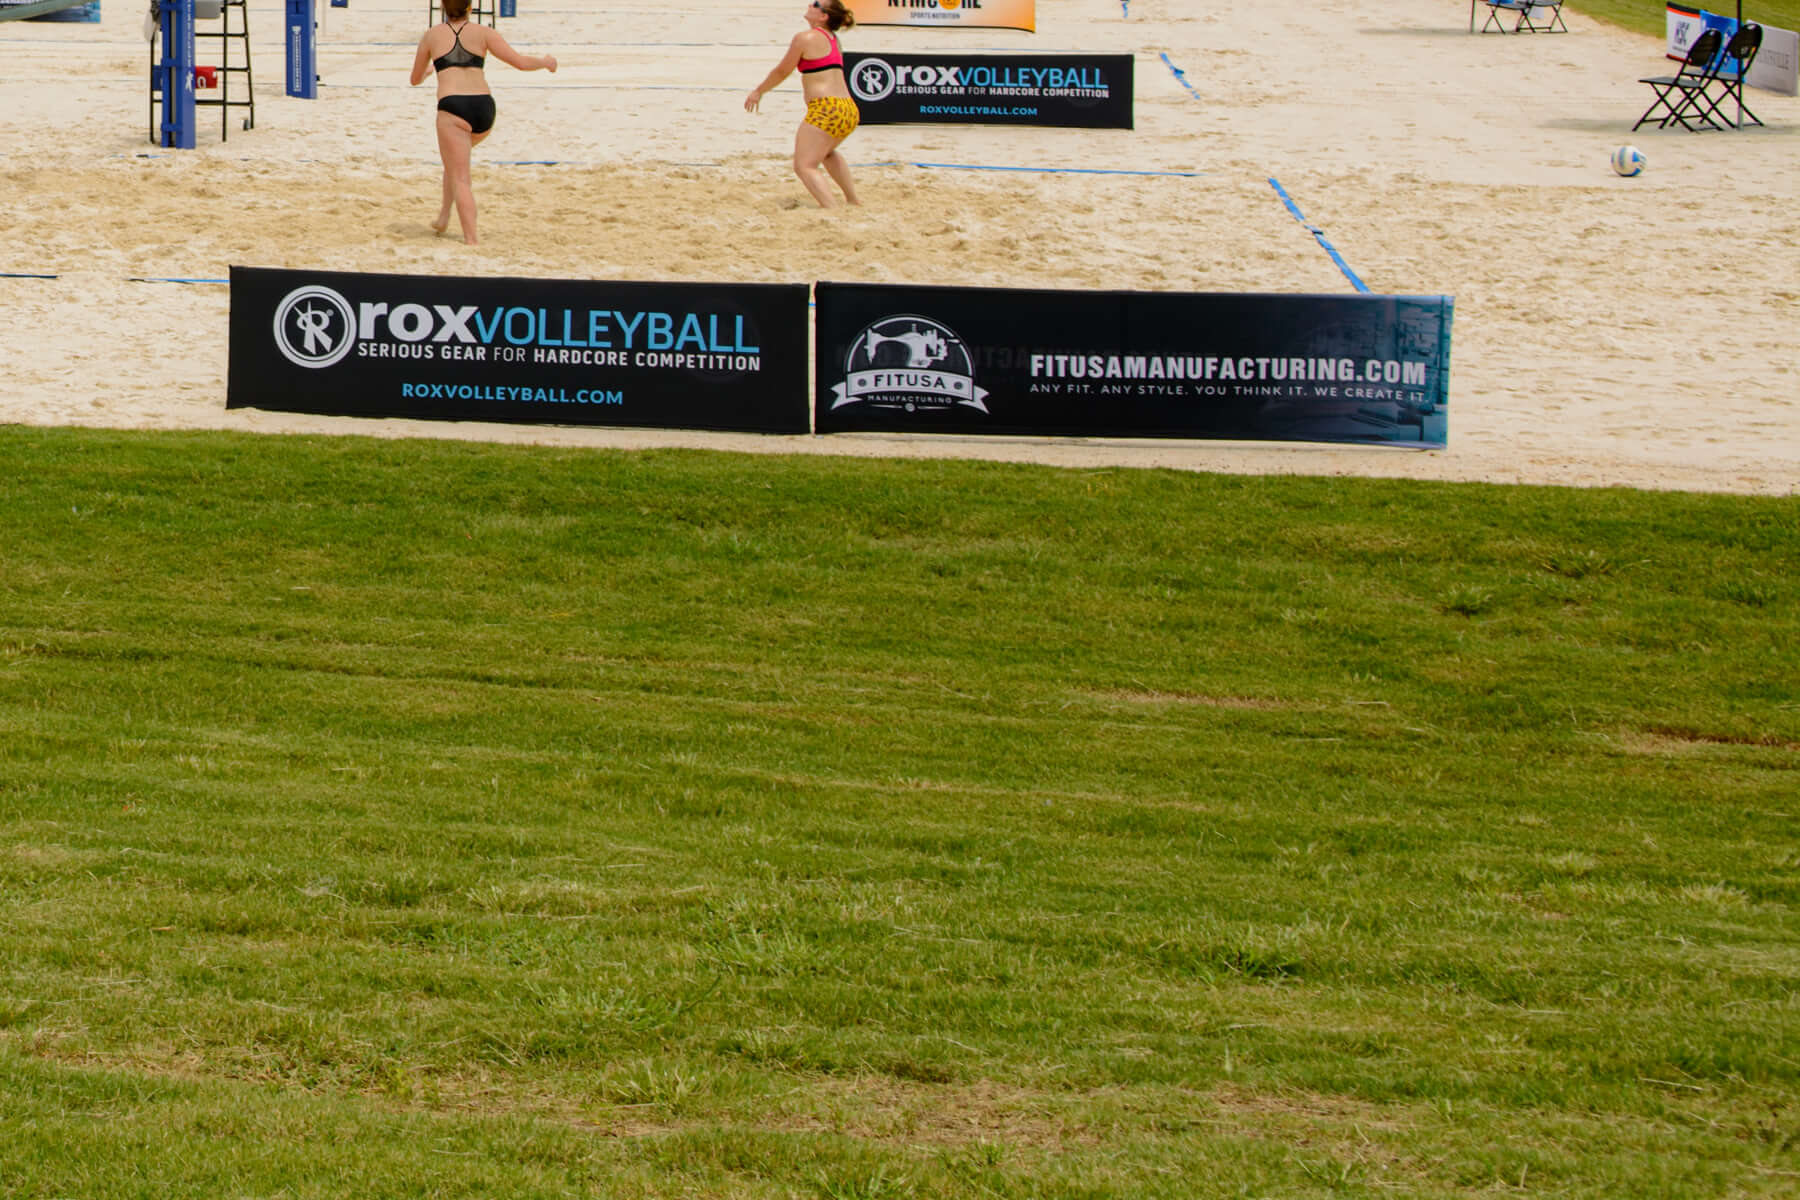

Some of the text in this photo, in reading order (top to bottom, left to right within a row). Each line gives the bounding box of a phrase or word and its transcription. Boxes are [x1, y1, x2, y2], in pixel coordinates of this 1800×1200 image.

[896, 85, 1109, 99] SERIOUS GEAR FOR HARDCORE COMPETITION
[920, 105, 1038, 116] ROXVOLLEYBALL.COM
[358, 301, 761, 354] roxVOLLEYBALL
[358, 342, 761, 372] SERIOUS GEAR FOR HARDCORE COMPETITION
[1030, 354, 1427, 386] FITUSAMANUFACTURING.COM
[873, 373, 946, 390] FITUSA
[402, 382, 624, 406] ROXVOLLEYBALL.COM
[867, 394, 953, 405] MANUFACTURING
[1030, 383, 1062, 393] ANY
[1067, 384, 1094, 394] FIT.
[1100, 384, 1132, 394] ANY
[1138, 385, 1189, 396] STYLE.
[1195, 386, 1227, 396] YOU
[1235, 386, 1282, 396] THINK
[1289, 386, 1308, 397] IT.
[1314, 387, 1338, 398] WE
[1344, 388, 1403, 401] CREATE
